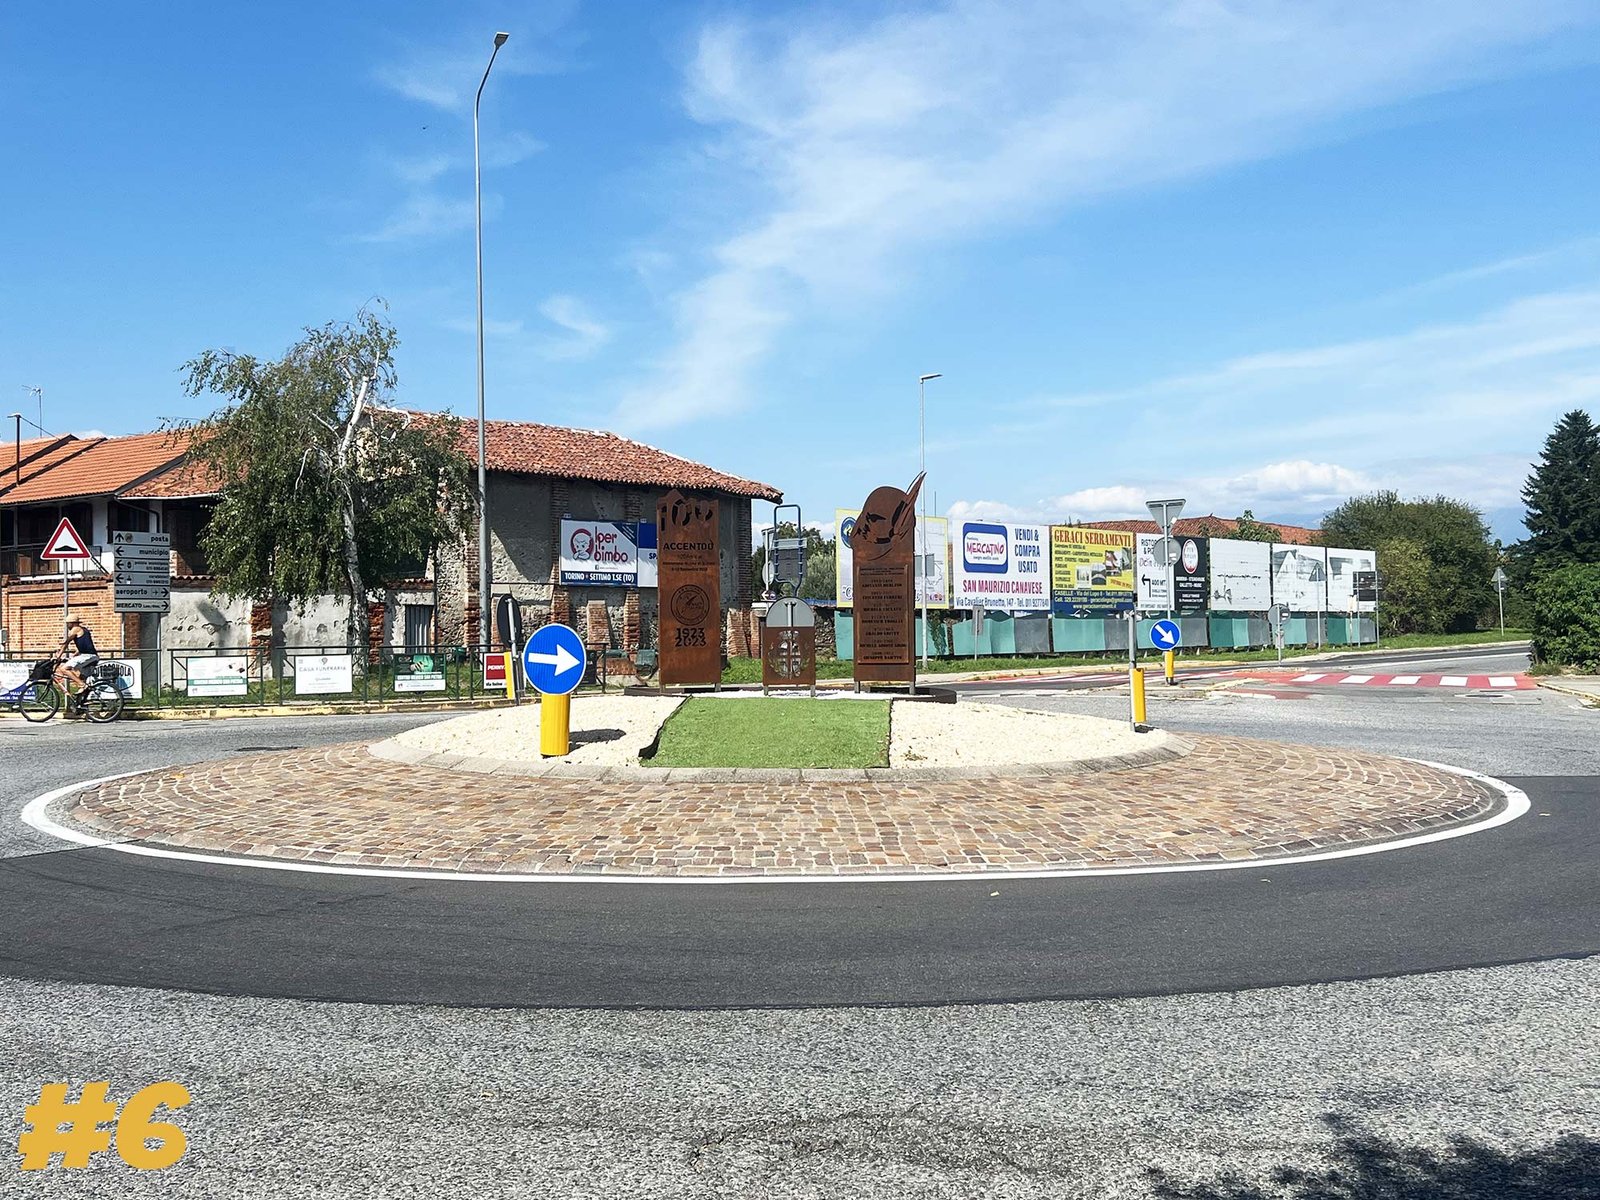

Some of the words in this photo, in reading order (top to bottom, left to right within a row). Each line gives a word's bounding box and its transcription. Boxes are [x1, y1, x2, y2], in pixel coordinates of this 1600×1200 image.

[595, 526, 617, 549] Iper
[1015, 528, 1033, 541] VENDI
[1034, 529, 1039, 541] &
[1054, 529, 1083, 544] GERACI
[1085, 532, 1131, 547] SERRAMENTI
[594, 545, 628, 562] bimbo
[966, 542, 1004, 556] MERCATINO
[1014, 544, 1040, 557] COMPRA
[1018, 560, 1037, 573] USATO
[623, 574, 634, 582] (TO)
[963, 580, 976, 592] SAN
[978, 580, 1010, 593] MAURIZIO
[1011, 581, 1043, 594] CANAVESE
[956, 597, 964, 606] Via
[676, 628, 704, 638] 1923
[675, 637, 706, 647] 2023
